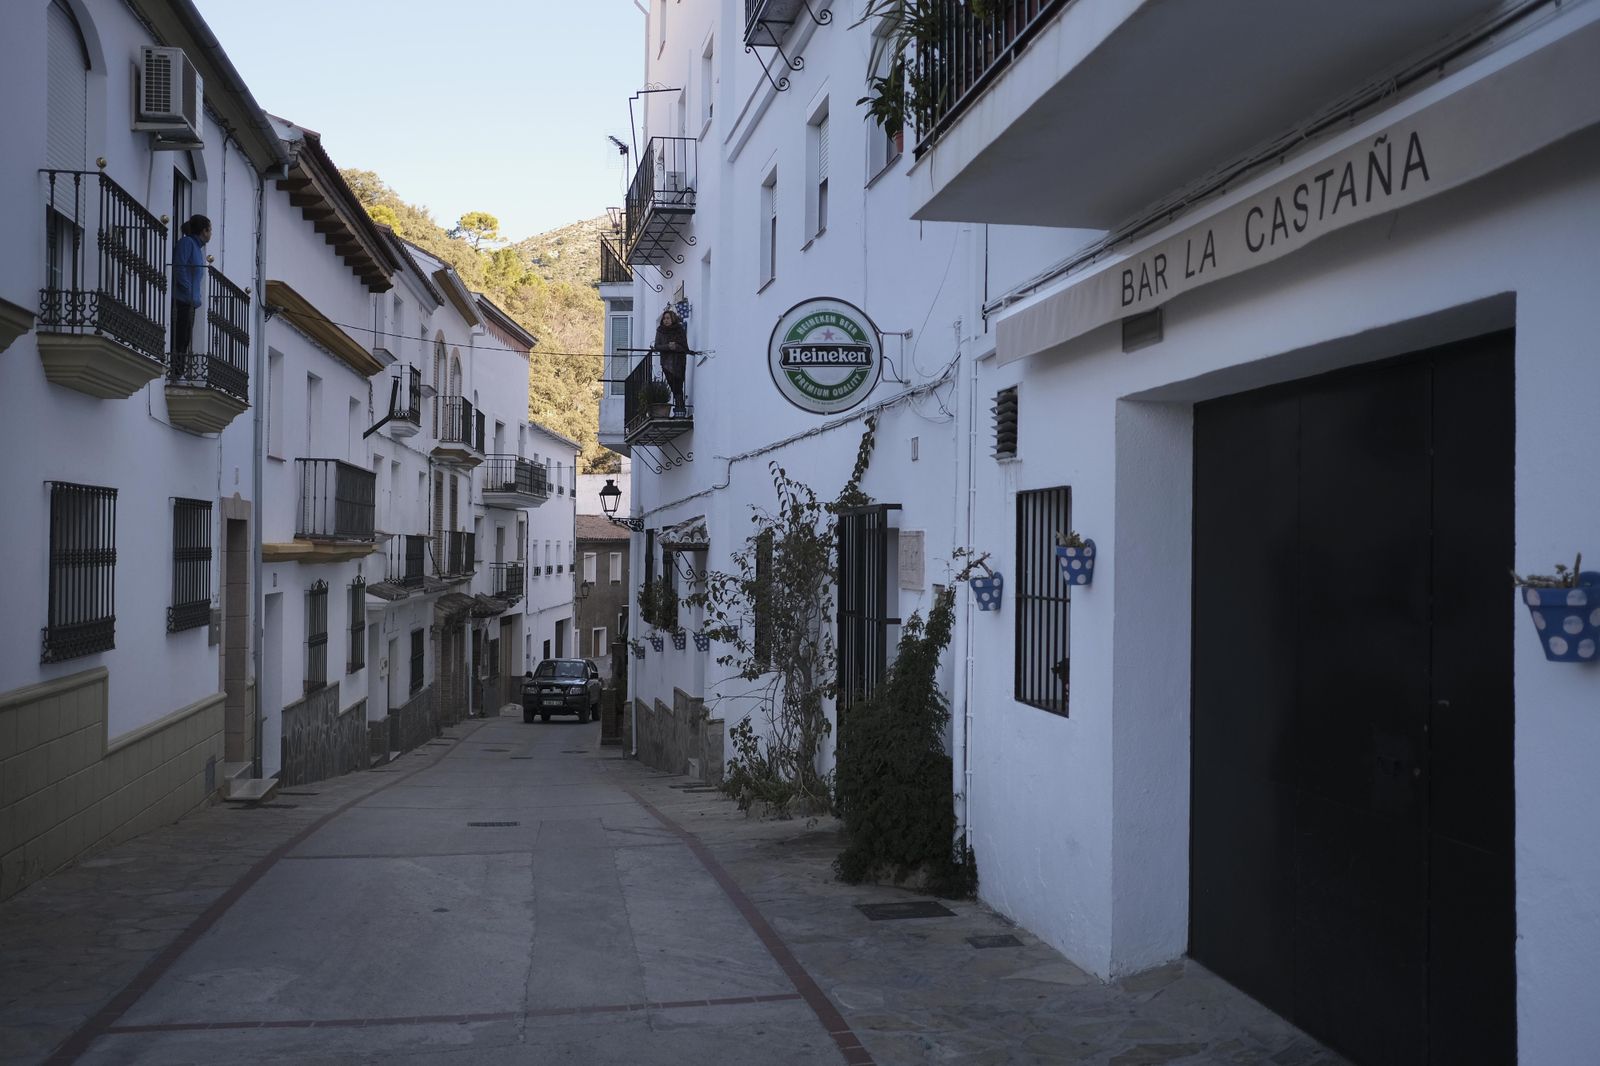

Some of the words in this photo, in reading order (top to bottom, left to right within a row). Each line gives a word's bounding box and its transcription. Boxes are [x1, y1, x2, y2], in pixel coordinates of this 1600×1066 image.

[1122, 253, 1168, 307] BAR
[1185, 229, 1217, 279] LA
[1245, 131, 1431, 253] CASTAÑA
[797, 315, 836, 334] HEINEKEN
[839, 317, 858, 335] BEER
[788, 348, 866, 363] Heineken
[794, 374, 829, 397] PREMIUM
[832, 374, 862, 396] QUALITY
